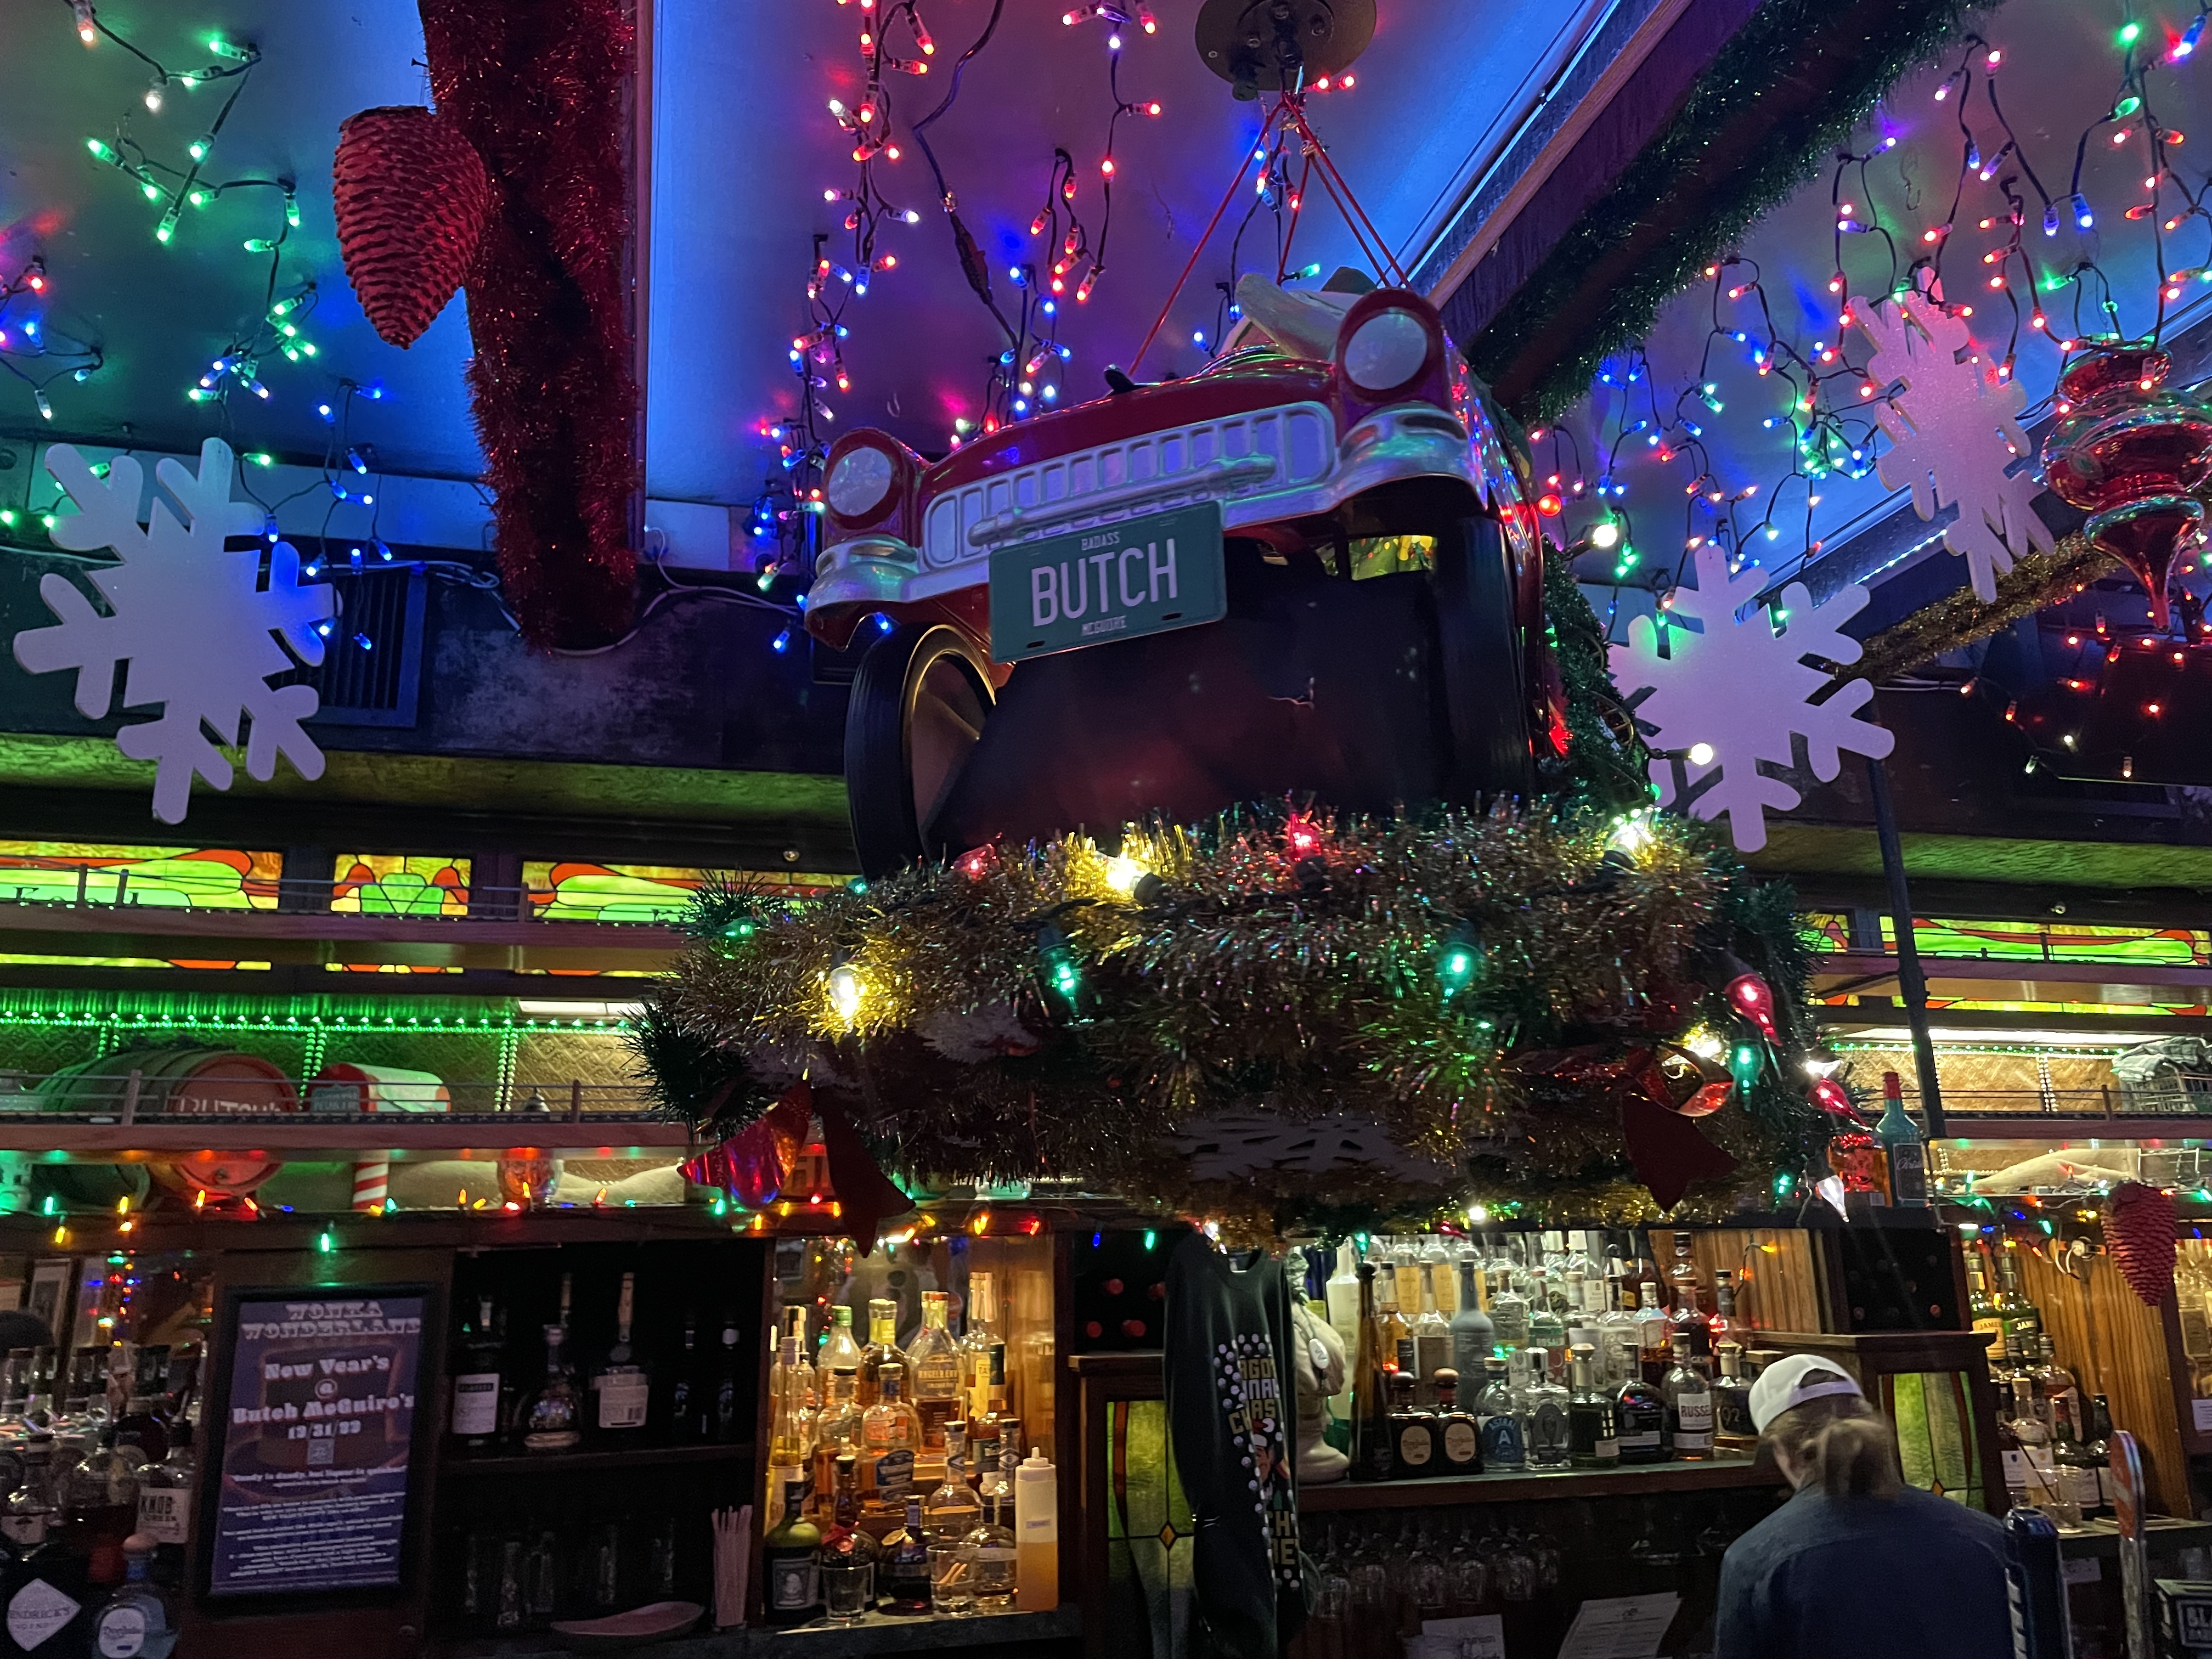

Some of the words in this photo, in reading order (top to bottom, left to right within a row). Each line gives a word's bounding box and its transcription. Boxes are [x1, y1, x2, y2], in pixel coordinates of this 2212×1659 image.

[1081, 532, 1120, 551] BADASS
[1031, 538, 1178, 627] BUTCH
[286, 1301, 383, 1320] WONKA
[241, 1318, 421, 1340] WONDERLAND
[264, 1363, 313, 1379] New
[319, 1356, 390, 1375] Year's
[314, 1378, 338, 1399] @
[232, 1403, 298, 1424] Butch
[303, 1393, 415, 1419] McGuire's
